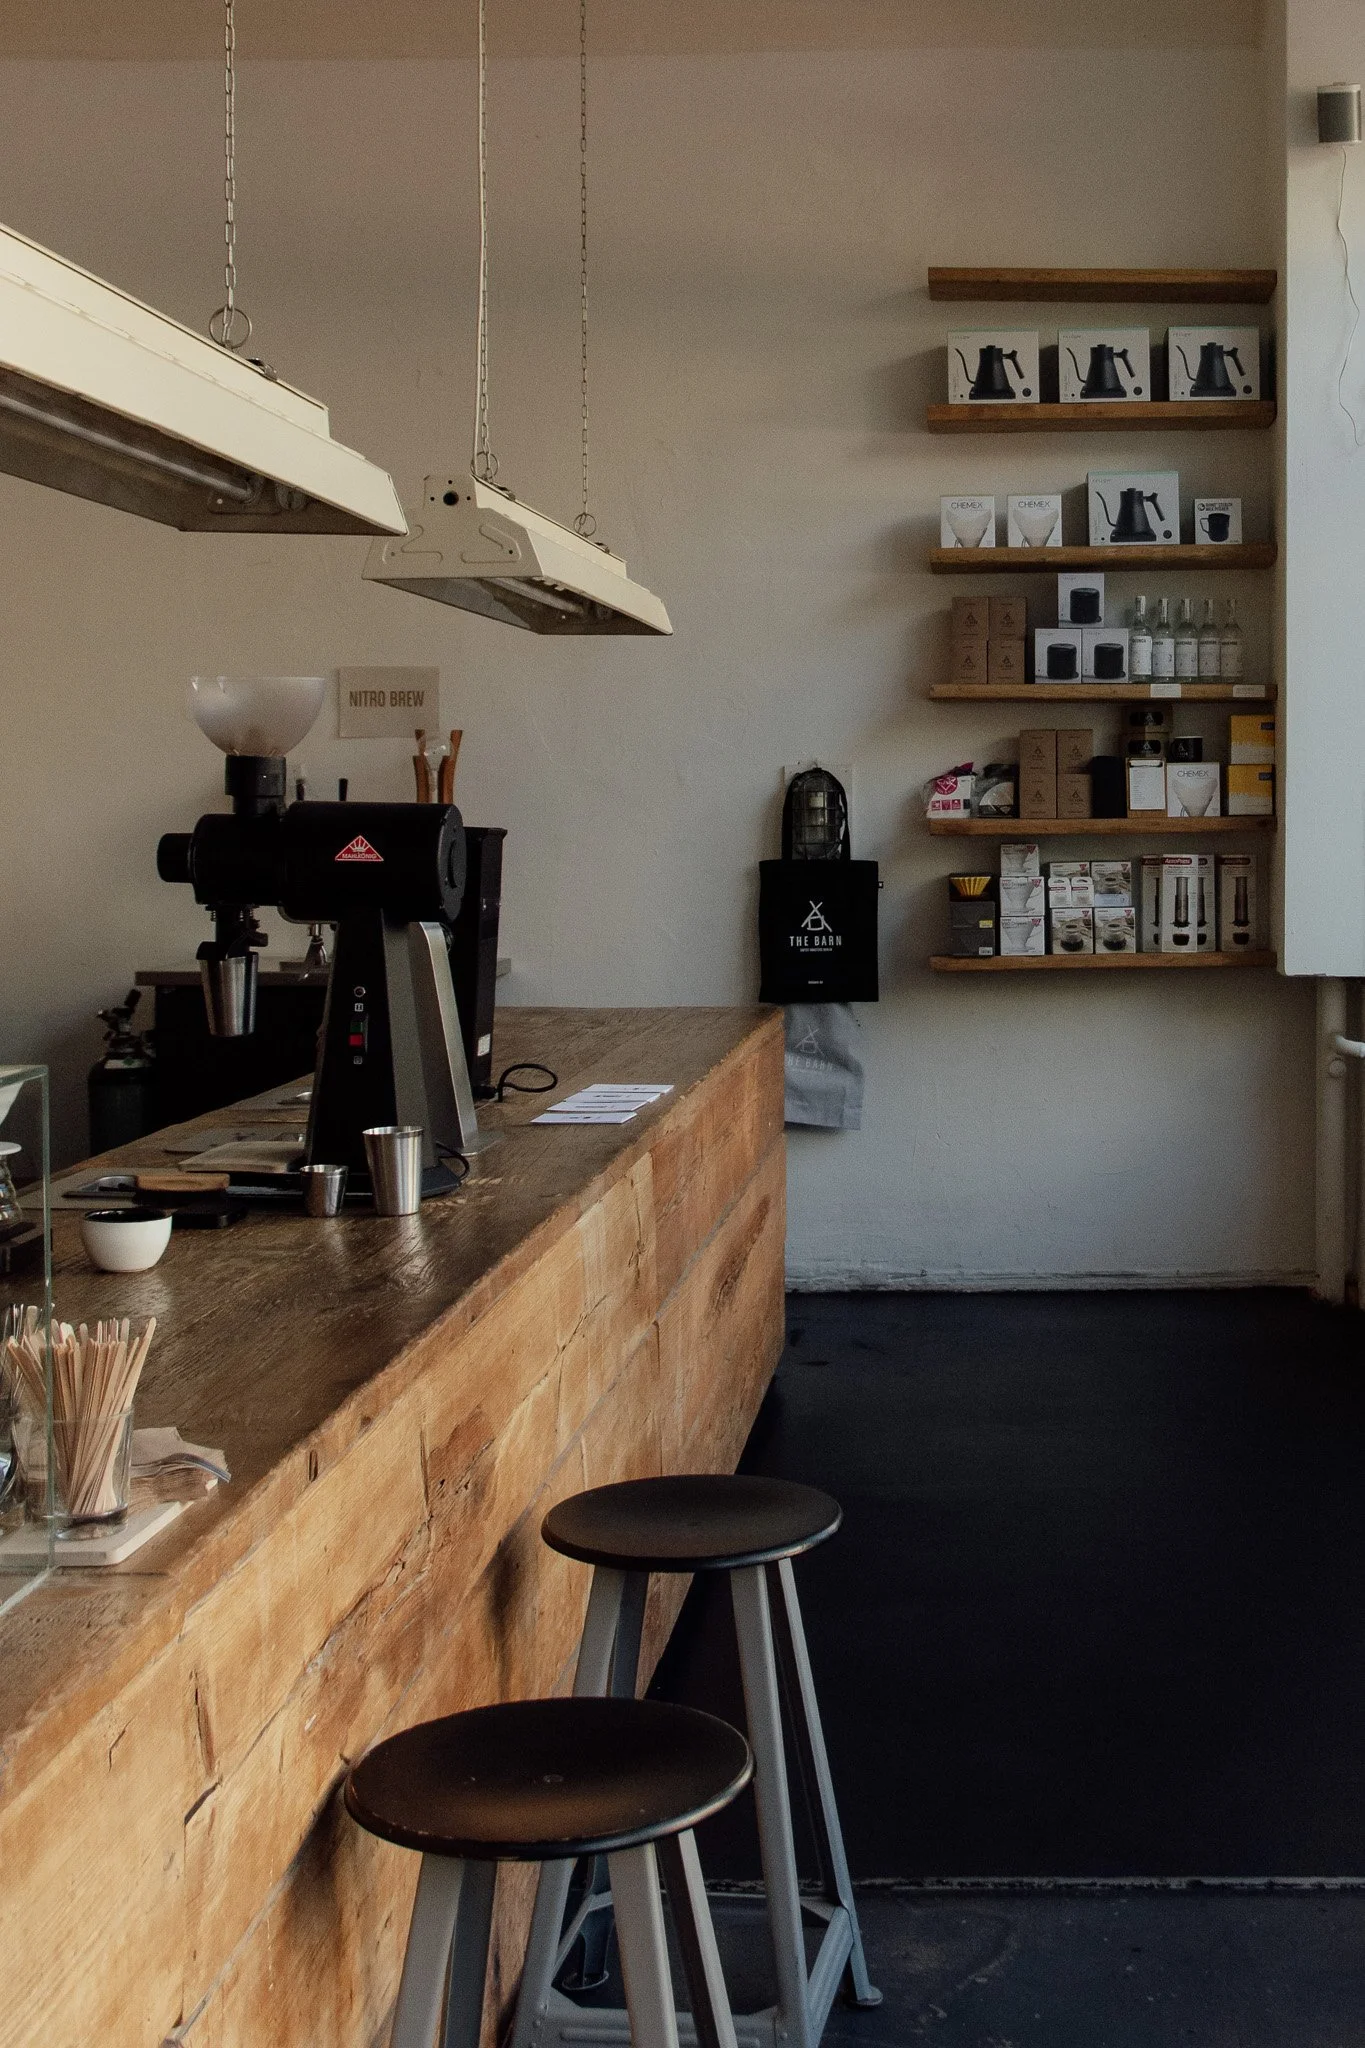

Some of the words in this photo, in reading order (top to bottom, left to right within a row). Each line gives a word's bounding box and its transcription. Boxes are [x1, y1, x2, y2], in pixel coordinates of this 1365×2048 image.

[1018, 500, 1051, 508] CHEMEX
[349, 690, 385, 707] NITRO
[390, 690, 425, 707] BREW
[789, 935, 809, 947] THE
[814, 935, 842, 947] BARN
